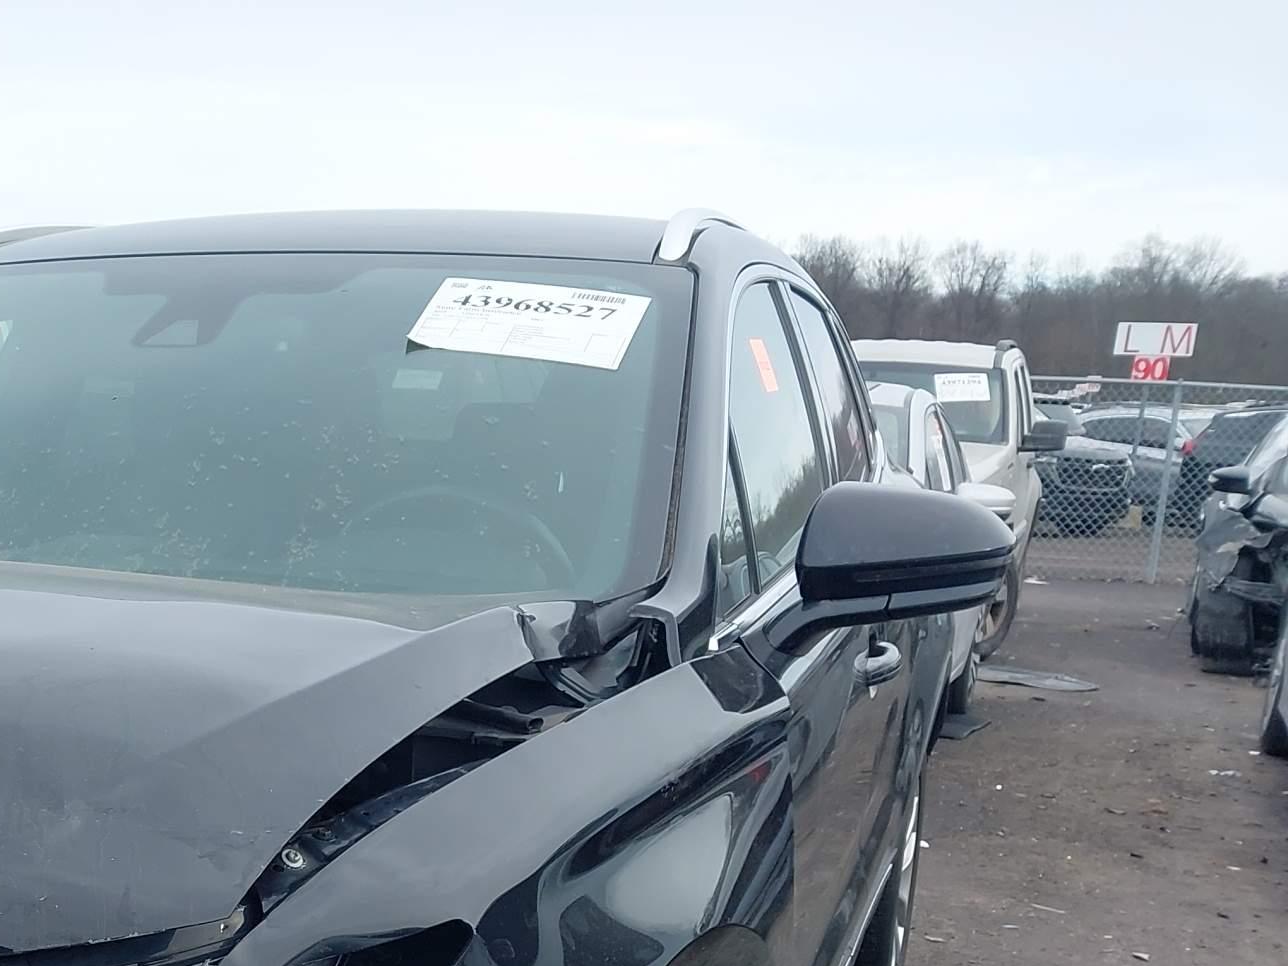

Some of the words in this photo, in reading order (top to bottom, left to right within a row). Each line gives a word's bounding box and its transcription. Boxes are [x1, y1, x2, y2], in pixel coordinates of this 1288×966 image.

[452, 293, 619, 321] 43968527
[1123, 324, 1140, 353] L
[1160, 324, 1193, 354] M
[1133, 357, 1168, 381] 90
